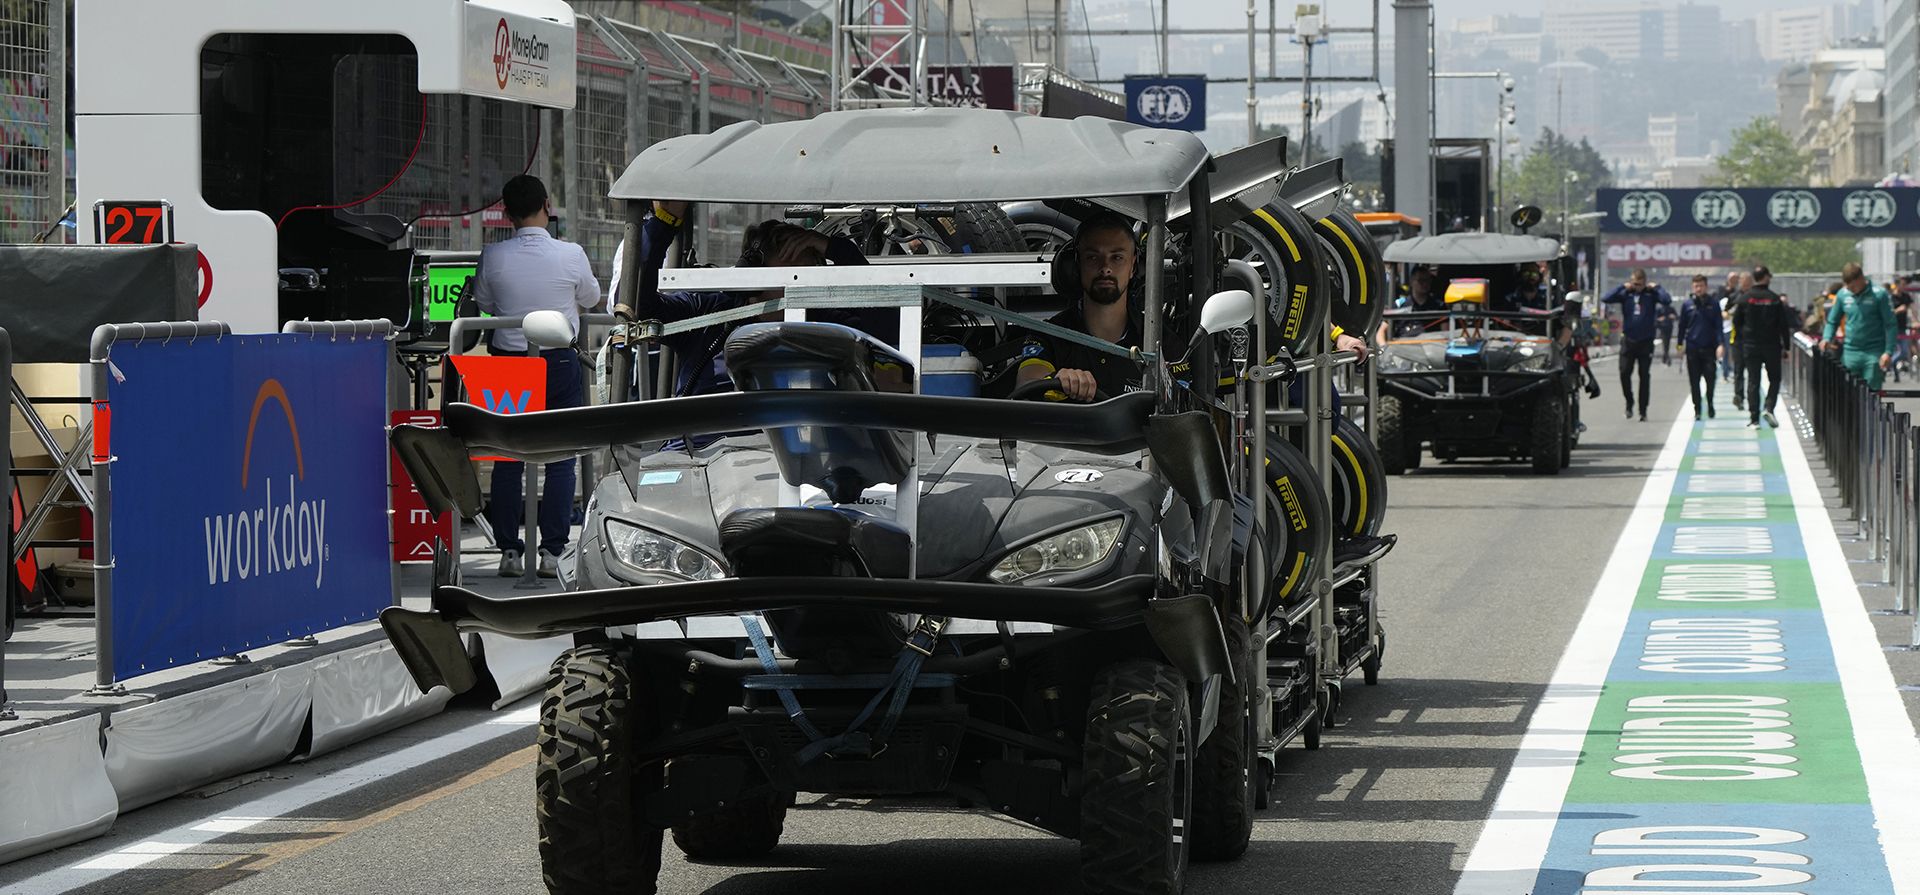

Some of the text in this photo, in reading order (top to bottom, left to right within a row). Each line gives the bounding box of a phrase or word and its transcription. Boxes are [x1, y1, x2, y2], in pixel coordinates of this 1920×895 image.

[511, 30, 549, 64] MoneyGram
[511, 68, 526, 85] HAAS
[534, 71, 549, 89] TEAM
[1141, 93, 1186, 115] FIA
[106, 207, 163, 244] 27
[1622, 199, 1665, 220] FIA
[1697, 199, 1740, 220] FIA
[1772, 198, 1816, 220] FIA
[1846, 198, 1890, 220] FIA
[1283, 284, 1308, 340] PIRELLI
[1275, 476, 1308, 532] PIRELLI
[205, 474, 326, 589] workday
[1637, 618, 1788, 673] aramco
[1609, 695, 1801, 781] aramco
